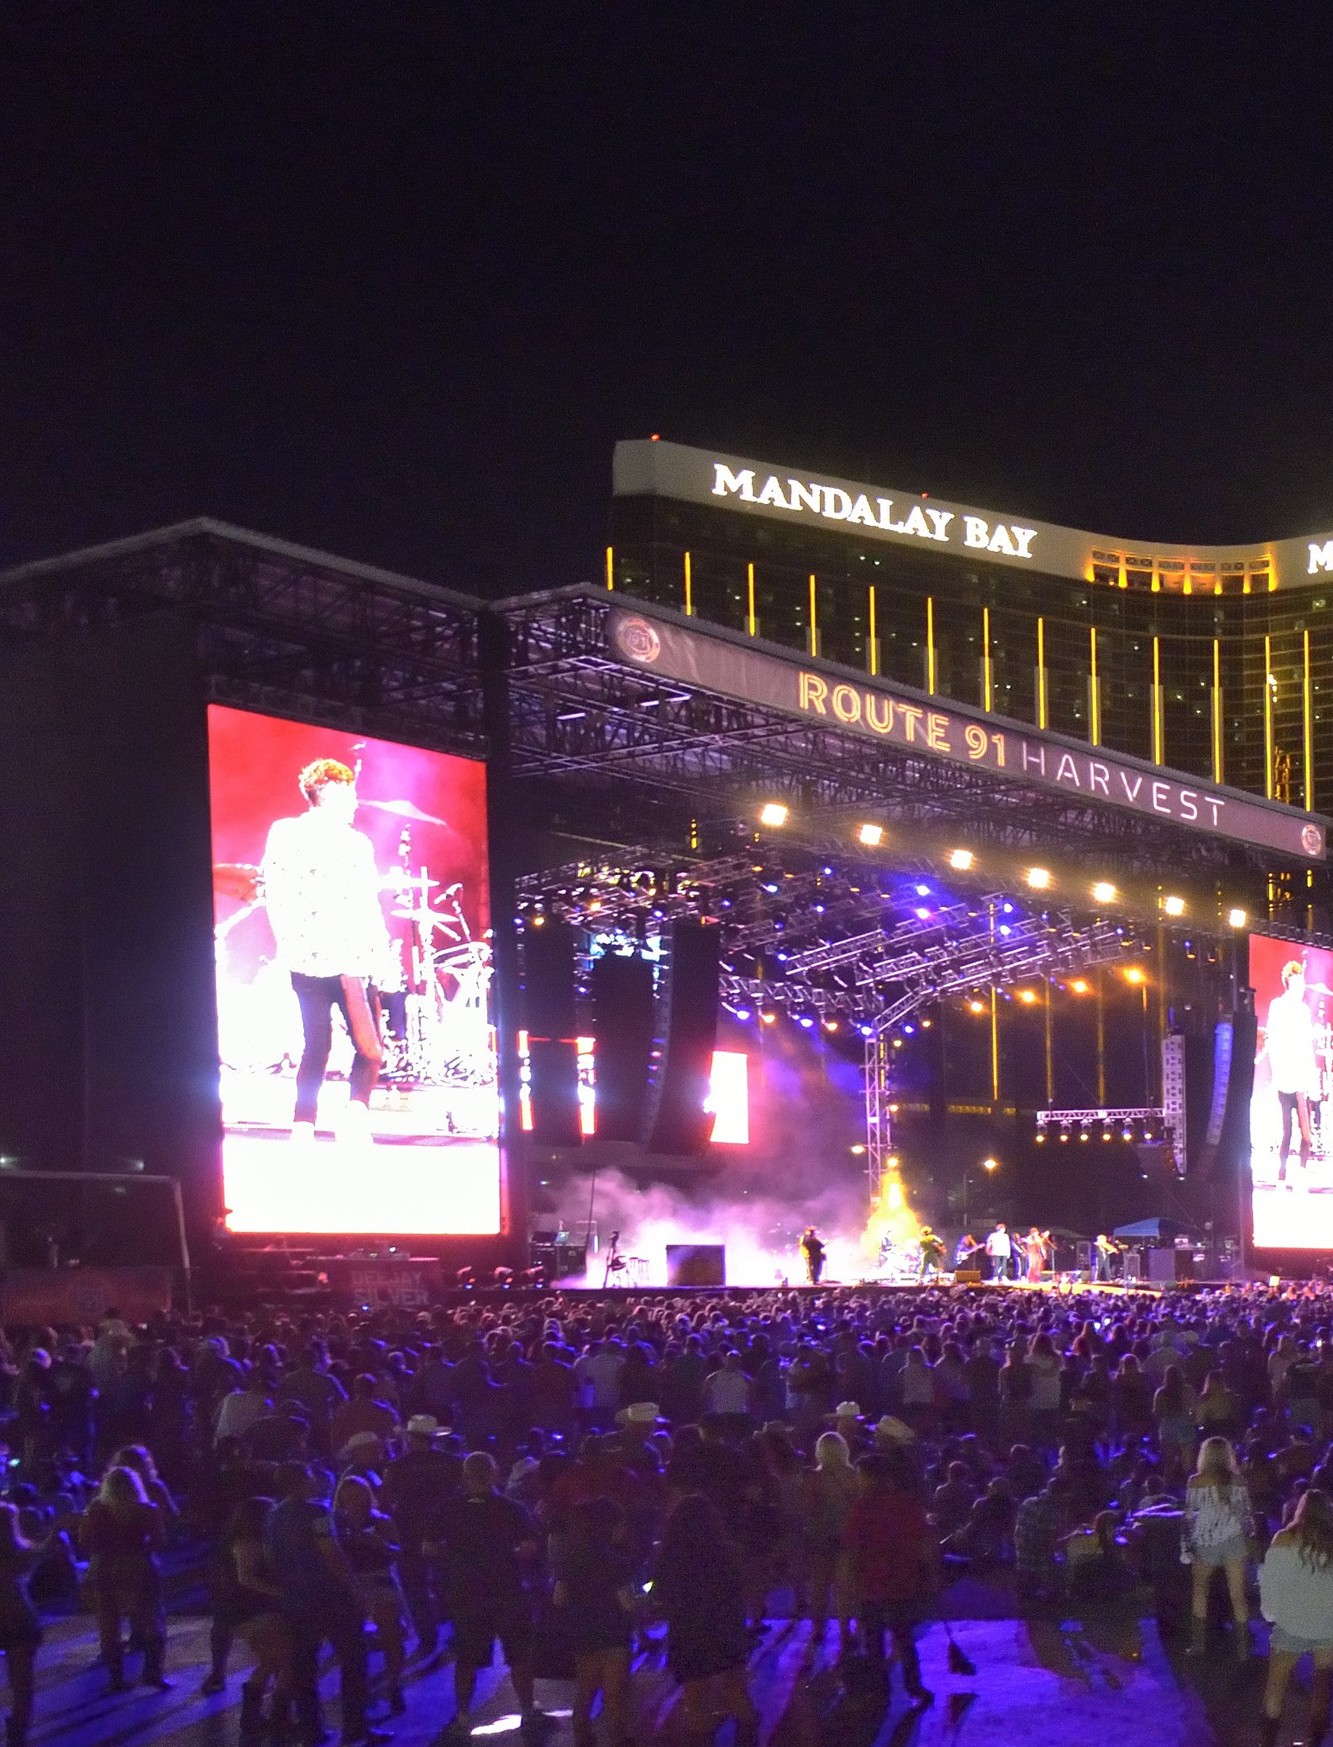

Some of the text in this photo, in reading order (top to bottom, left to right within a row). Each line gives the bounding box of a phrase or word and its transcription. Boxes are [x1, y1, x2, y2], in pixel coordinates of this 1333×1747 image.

[712, 464, 1038, 558] MANDALAY BAY
[800, 671, 1225, 826] ROUTE 91 HARVEST
[354, 1288, 429, 1306] SILVER
